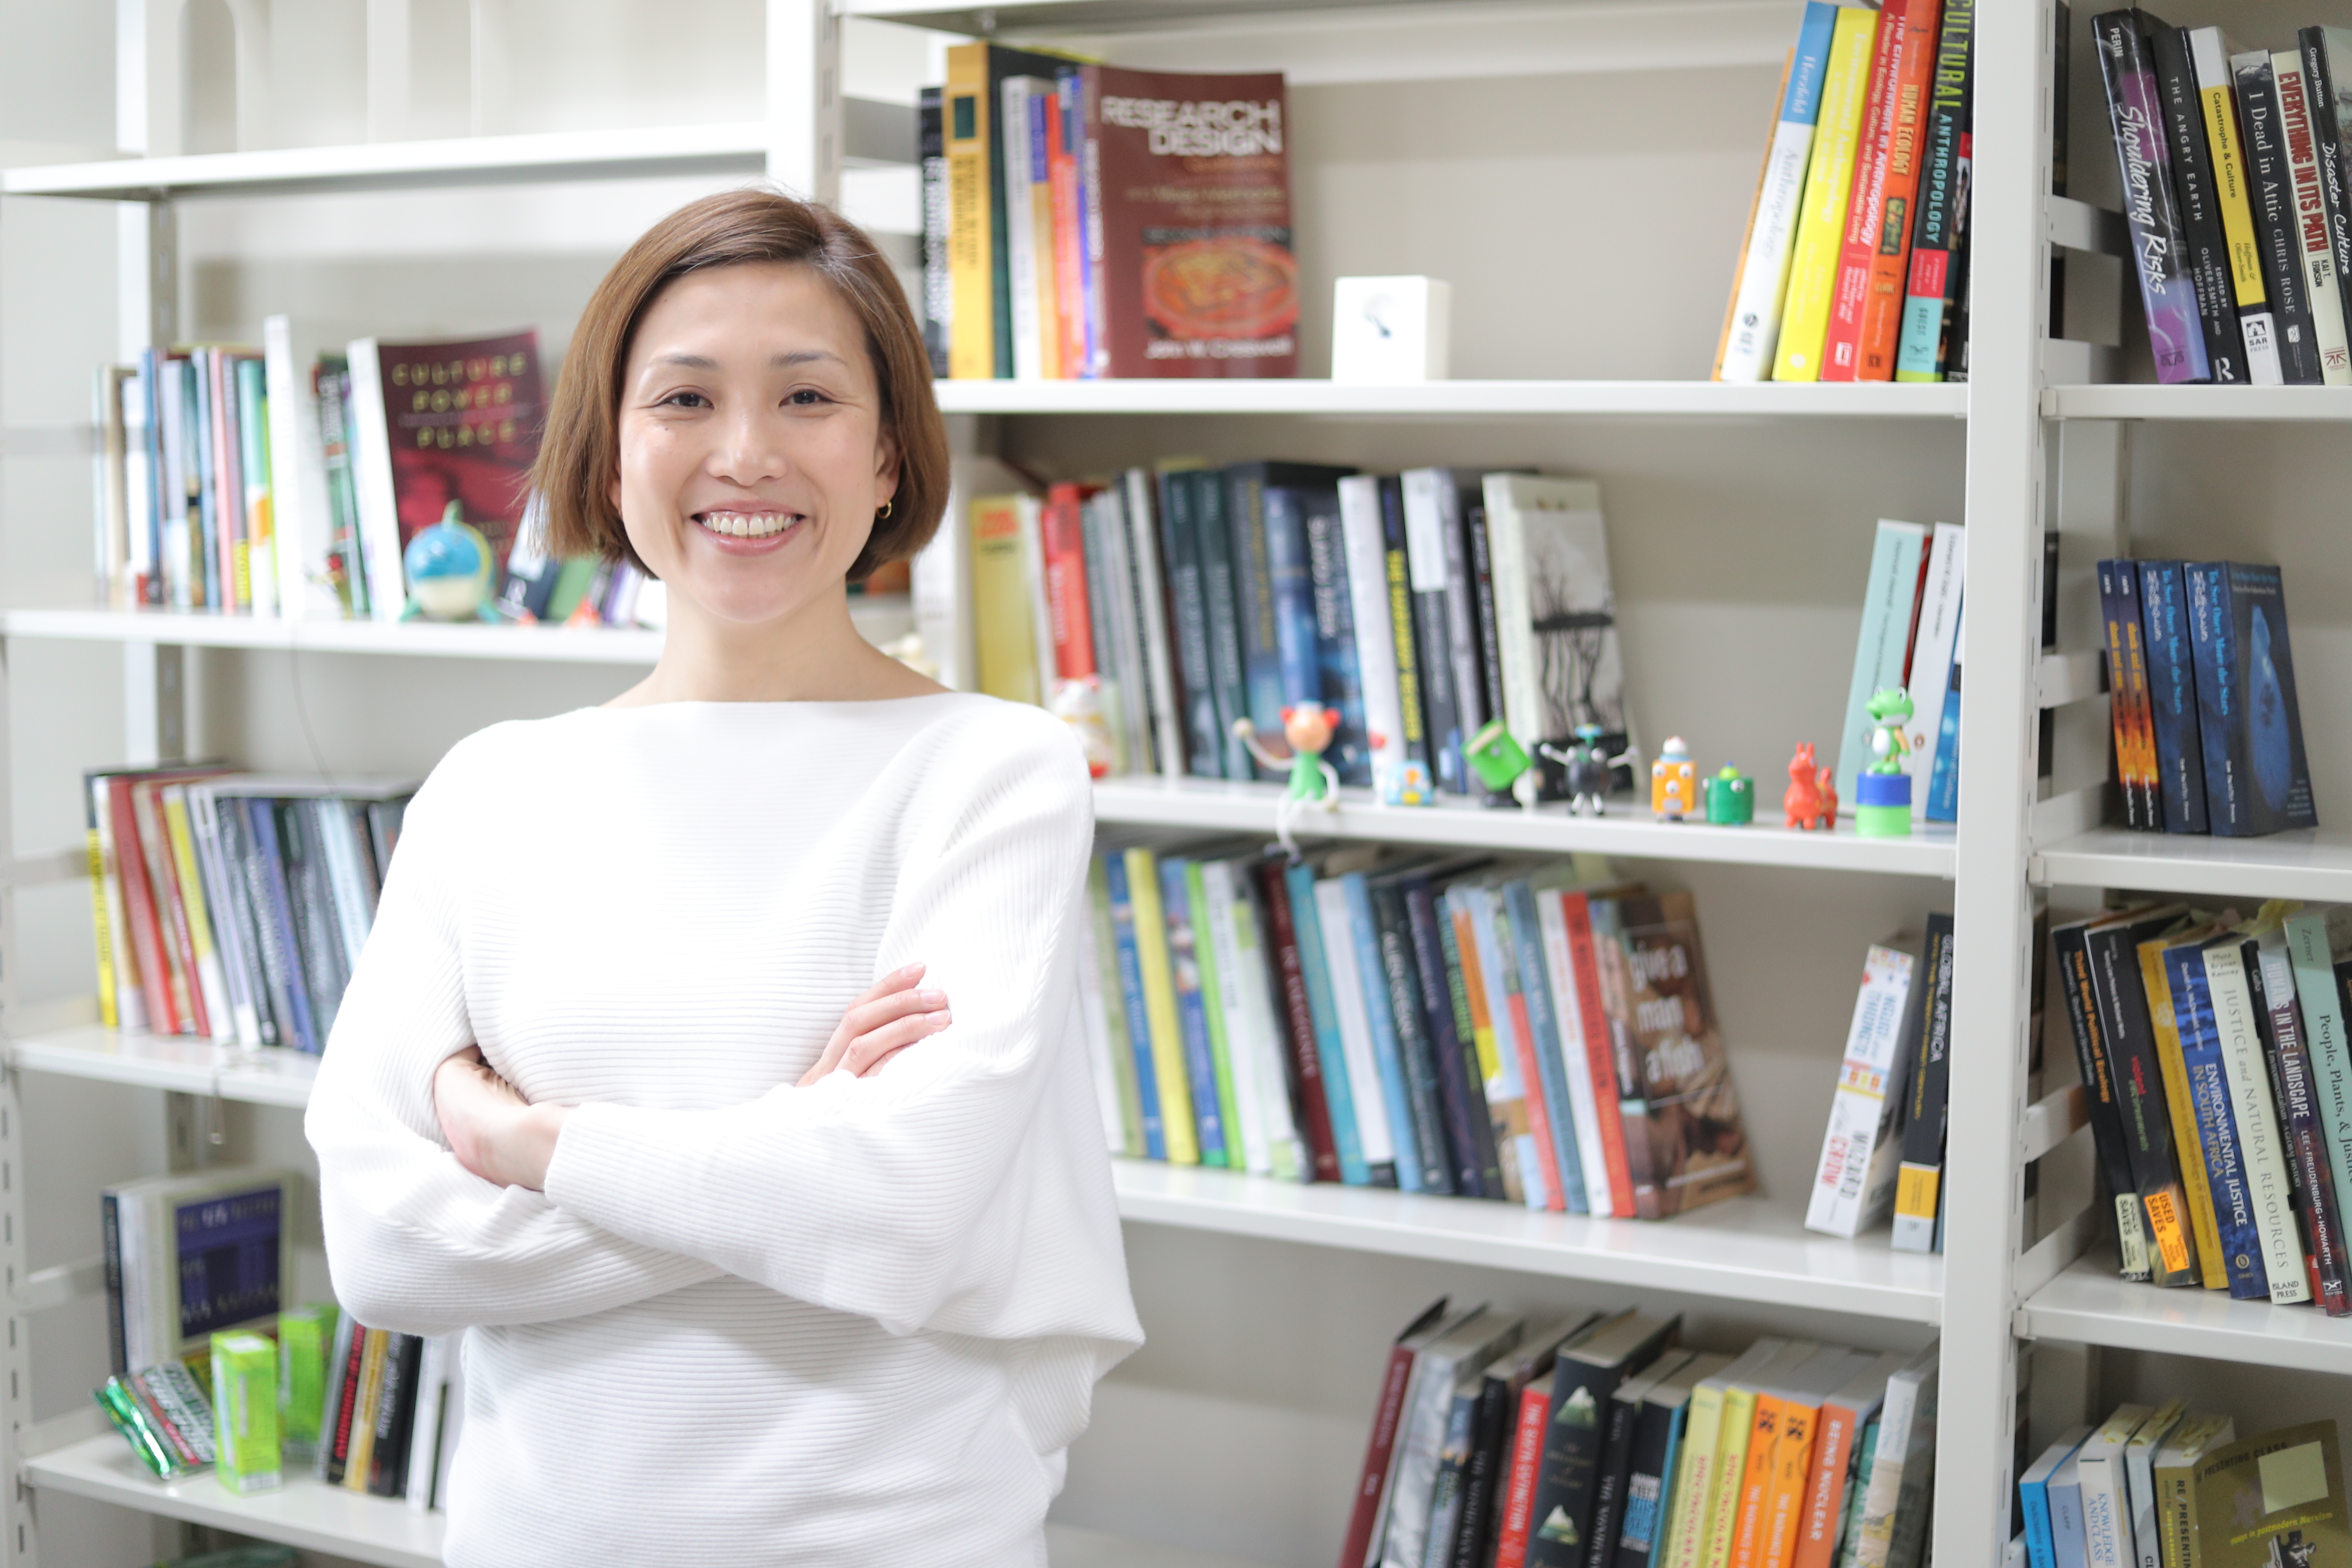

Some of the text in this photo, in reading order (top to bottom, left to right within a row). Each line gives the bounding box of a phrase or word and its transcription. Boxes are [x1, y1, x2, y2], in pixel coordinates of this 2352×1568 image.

[1933, 0, 1972, 114] CULTURAL
[2110, 27, 2124, 58] PERIN
[2307, 47, 2326, 107] Gregory Button
[1891, 82, 1919, 175] HUMAN ECOLOGY
[2170, 77, 2203, 221] THE ANGRY EARTH
[2211, 92, 2229, 149] Catastrophe
[2224, 162, 2238, 198] Culture
[2250, 107, 2273, 151] Dead
[2277, 71, 2329, 252] EVERYTHING IN ITS PATH
[1926, 113, 1953, 243] ANTHROPOLOGY
[2110, 101, 2175, 298] Shouldering Risks
[2259, 156, 2275, 174] in
[2261, 178, 2284, 222] Attic
[2320, 141, 2352, 275] Disaster Culture
[2193, 267, 2208, 316] HOFFMAN
[2200, 247, 2220, 317] OLIVER-SMITH
[2215, 266, 2228, 308] EDITED BY
[2272, 228, 2296, 314] CHRIS ROSE
[2311, 261, 2323, 287] ERIKSON
[2320, 259, 2330, 271] KAI
[2161, 567, 2174, 584] To
[2208, 569, 2220, 584] To
[2301, 927, 2317, 963] Zerner
[1929, 934, 1955, 1064] GLOBAL AFRICA
[2264, 962, 2310, 1119] HUMANS IN THE LANDSCAPE
[2314, 1014, 2351, 1133] People, Plants, &
[2093, 1059, 2112, 1104] Ecology
[2192, 1064, 2225, 1178] IN SOUTH AFRICA
[2204, 1063, 2248, 1227] ENVIRONMENTAL JUSTICE
[2223, 988, 2289, 1269] JUSTICE and NATURAL RESOURCES
[2147, 1197, 2167, 1233] SAVES
[2158, 1194, 2175, 1223] USED
[2300, 1130, 2332, 1265] LEE FREUDENBURG HOWARTH
[2272, 1280, 2299, 1289] ISLAND
[1809, 1419, 1843, 1541] BEING NUCLEAR
[2088, 1498, 2103, 1561] AND CLASS
[2097, 1493, 2114, 1566] KNOWLEDGE
